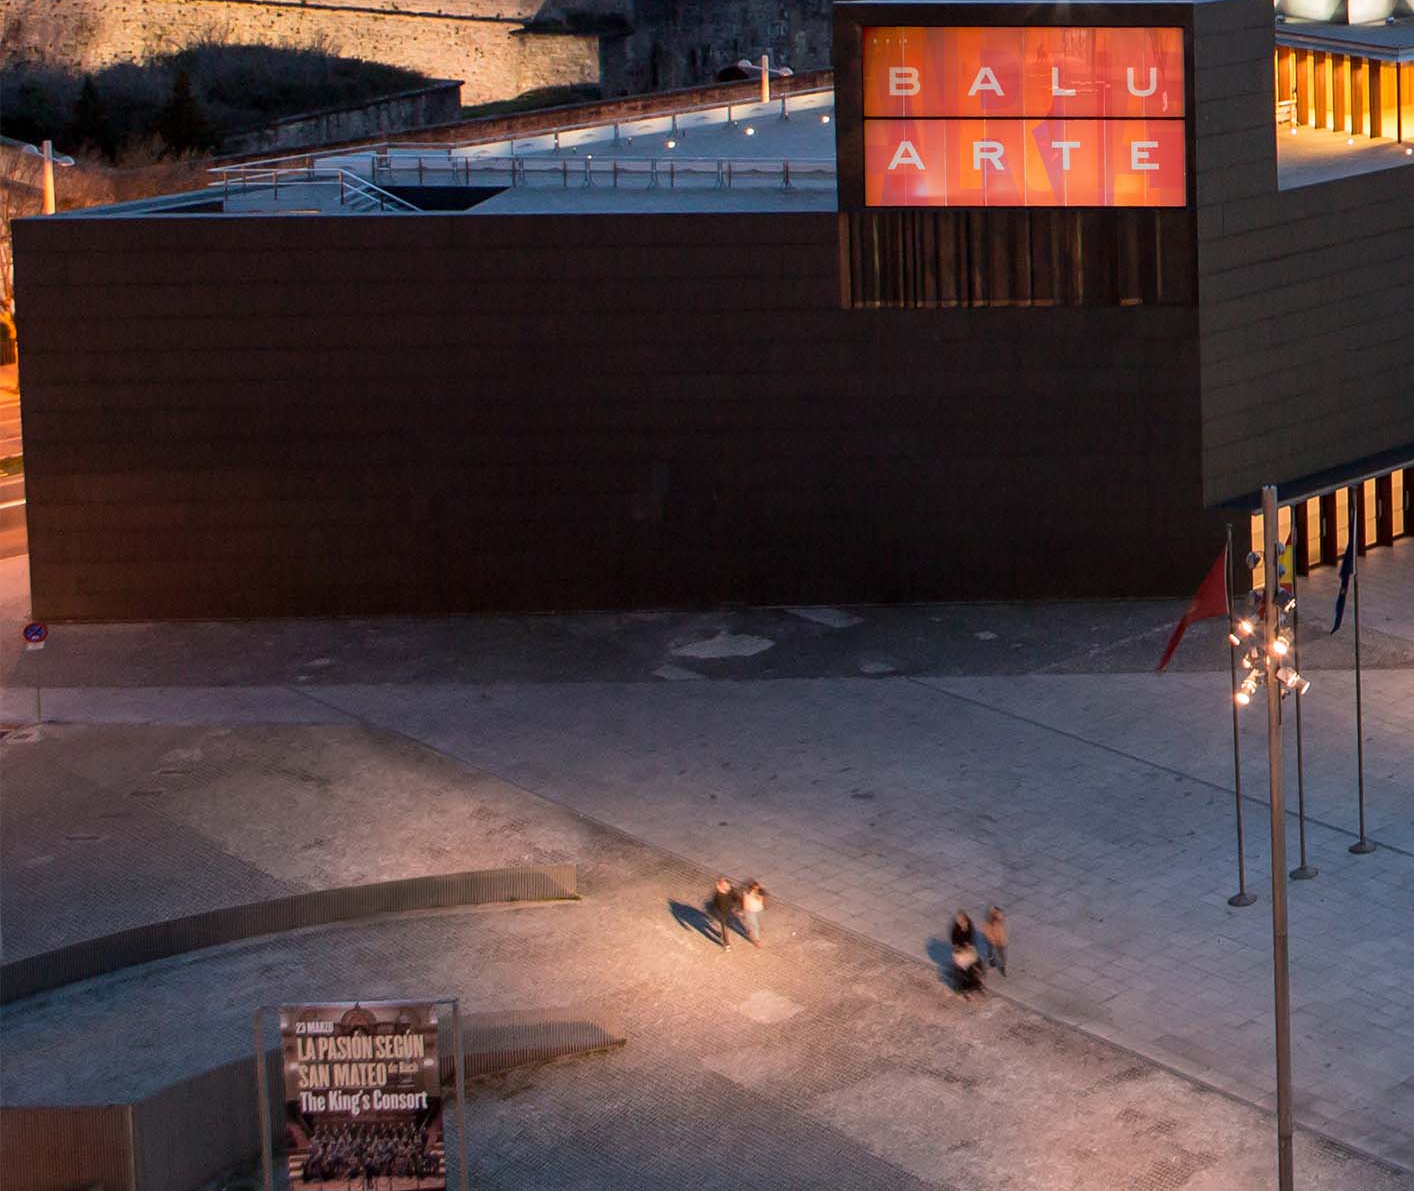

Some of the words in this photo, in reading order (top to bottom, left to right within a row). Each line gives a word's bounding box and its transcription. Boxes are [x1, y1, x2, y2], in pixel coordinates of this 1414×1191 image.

[888, 66, 1157, 96] BALU
[887, 140, 1160, 171] ARTE
[298, 1037, 316, 1060] LA
[319, 1031, 373, 1060] PASIÓN
[376, 1030, 425, 1058] SEGÚN
[299, 1064, 330, 1088] SAN
[334, 1062, 387, 1087] MATEO
[300, 1092, 325, 1112] The
[329, 1089, 370, 1115] King's
[373, 1088, 428, 1111] Consort
